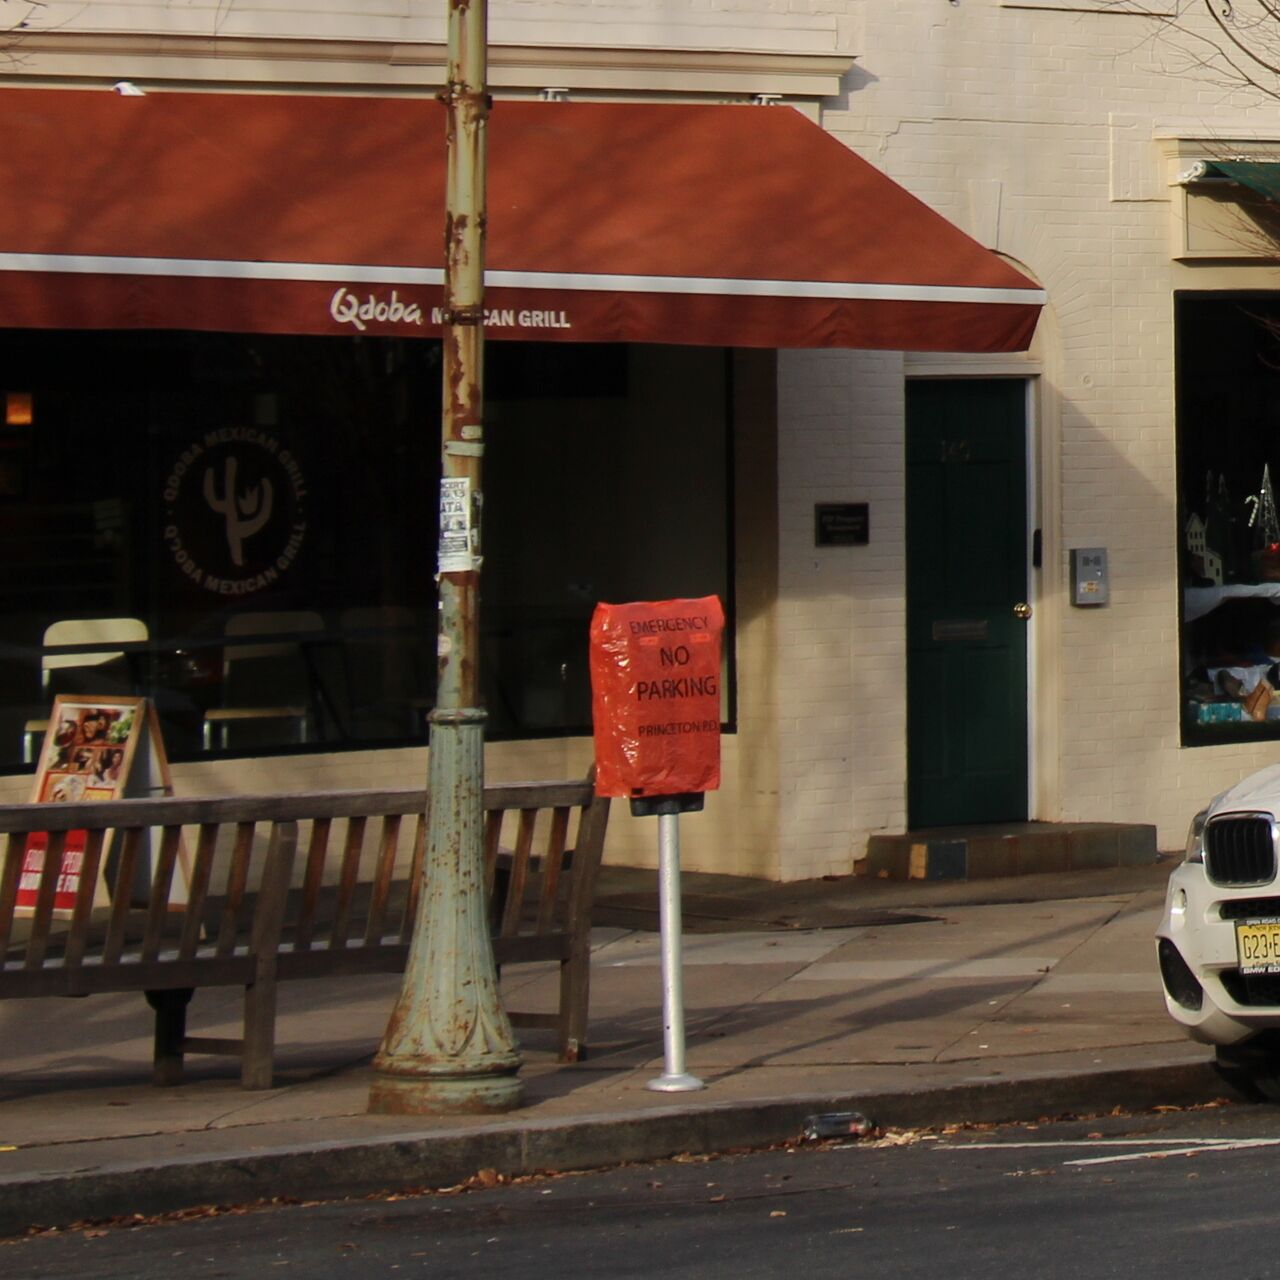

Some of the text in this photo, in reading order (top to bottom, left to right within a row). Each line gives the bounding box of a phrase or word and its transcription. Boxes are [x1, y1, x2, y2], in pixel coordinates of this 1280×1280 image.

[330, 287, 572, 331] Qdoba MCAN GRILL
[163, 426, 307, 502] QDOBA MEXICAN GRILL
[204, 567, 279, 595] MEXICAN
[277, 522, 307, 570] GRILL
[629, 616, 709, 634] EMERGENCY
[660, 645, 690, 667] NO
[637, 676, 717, 701] PARKING
[638, 721, 700, 737] PRINCETON
[1243, 966, 1266, 974] BMW
